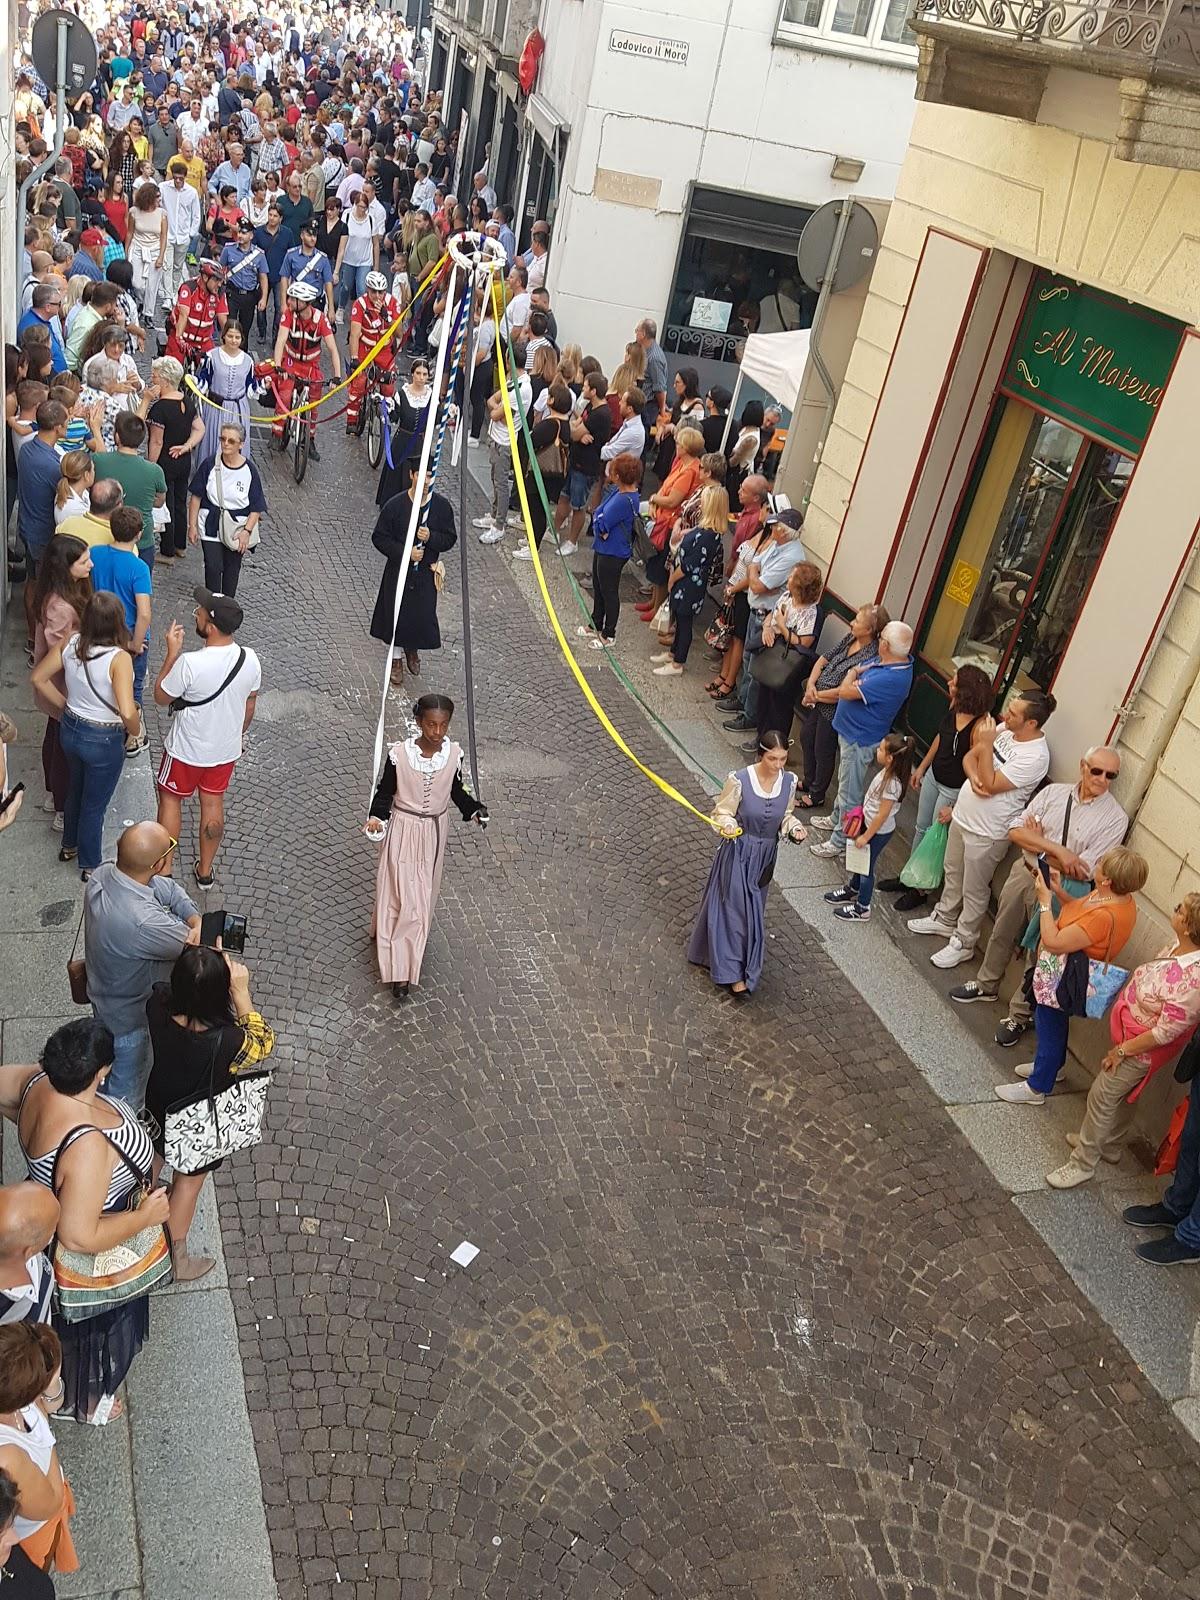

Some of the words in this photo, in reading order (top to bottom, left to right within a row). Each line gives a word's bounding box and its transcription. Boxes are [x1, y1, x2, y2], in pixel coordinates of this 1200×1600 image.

[611, 38, 653, 53] Lodovico
[664, 48, 687, 60] Moro
[658, 40, 687, 49] contrada
[1034, 327, 1077, 366] Al
